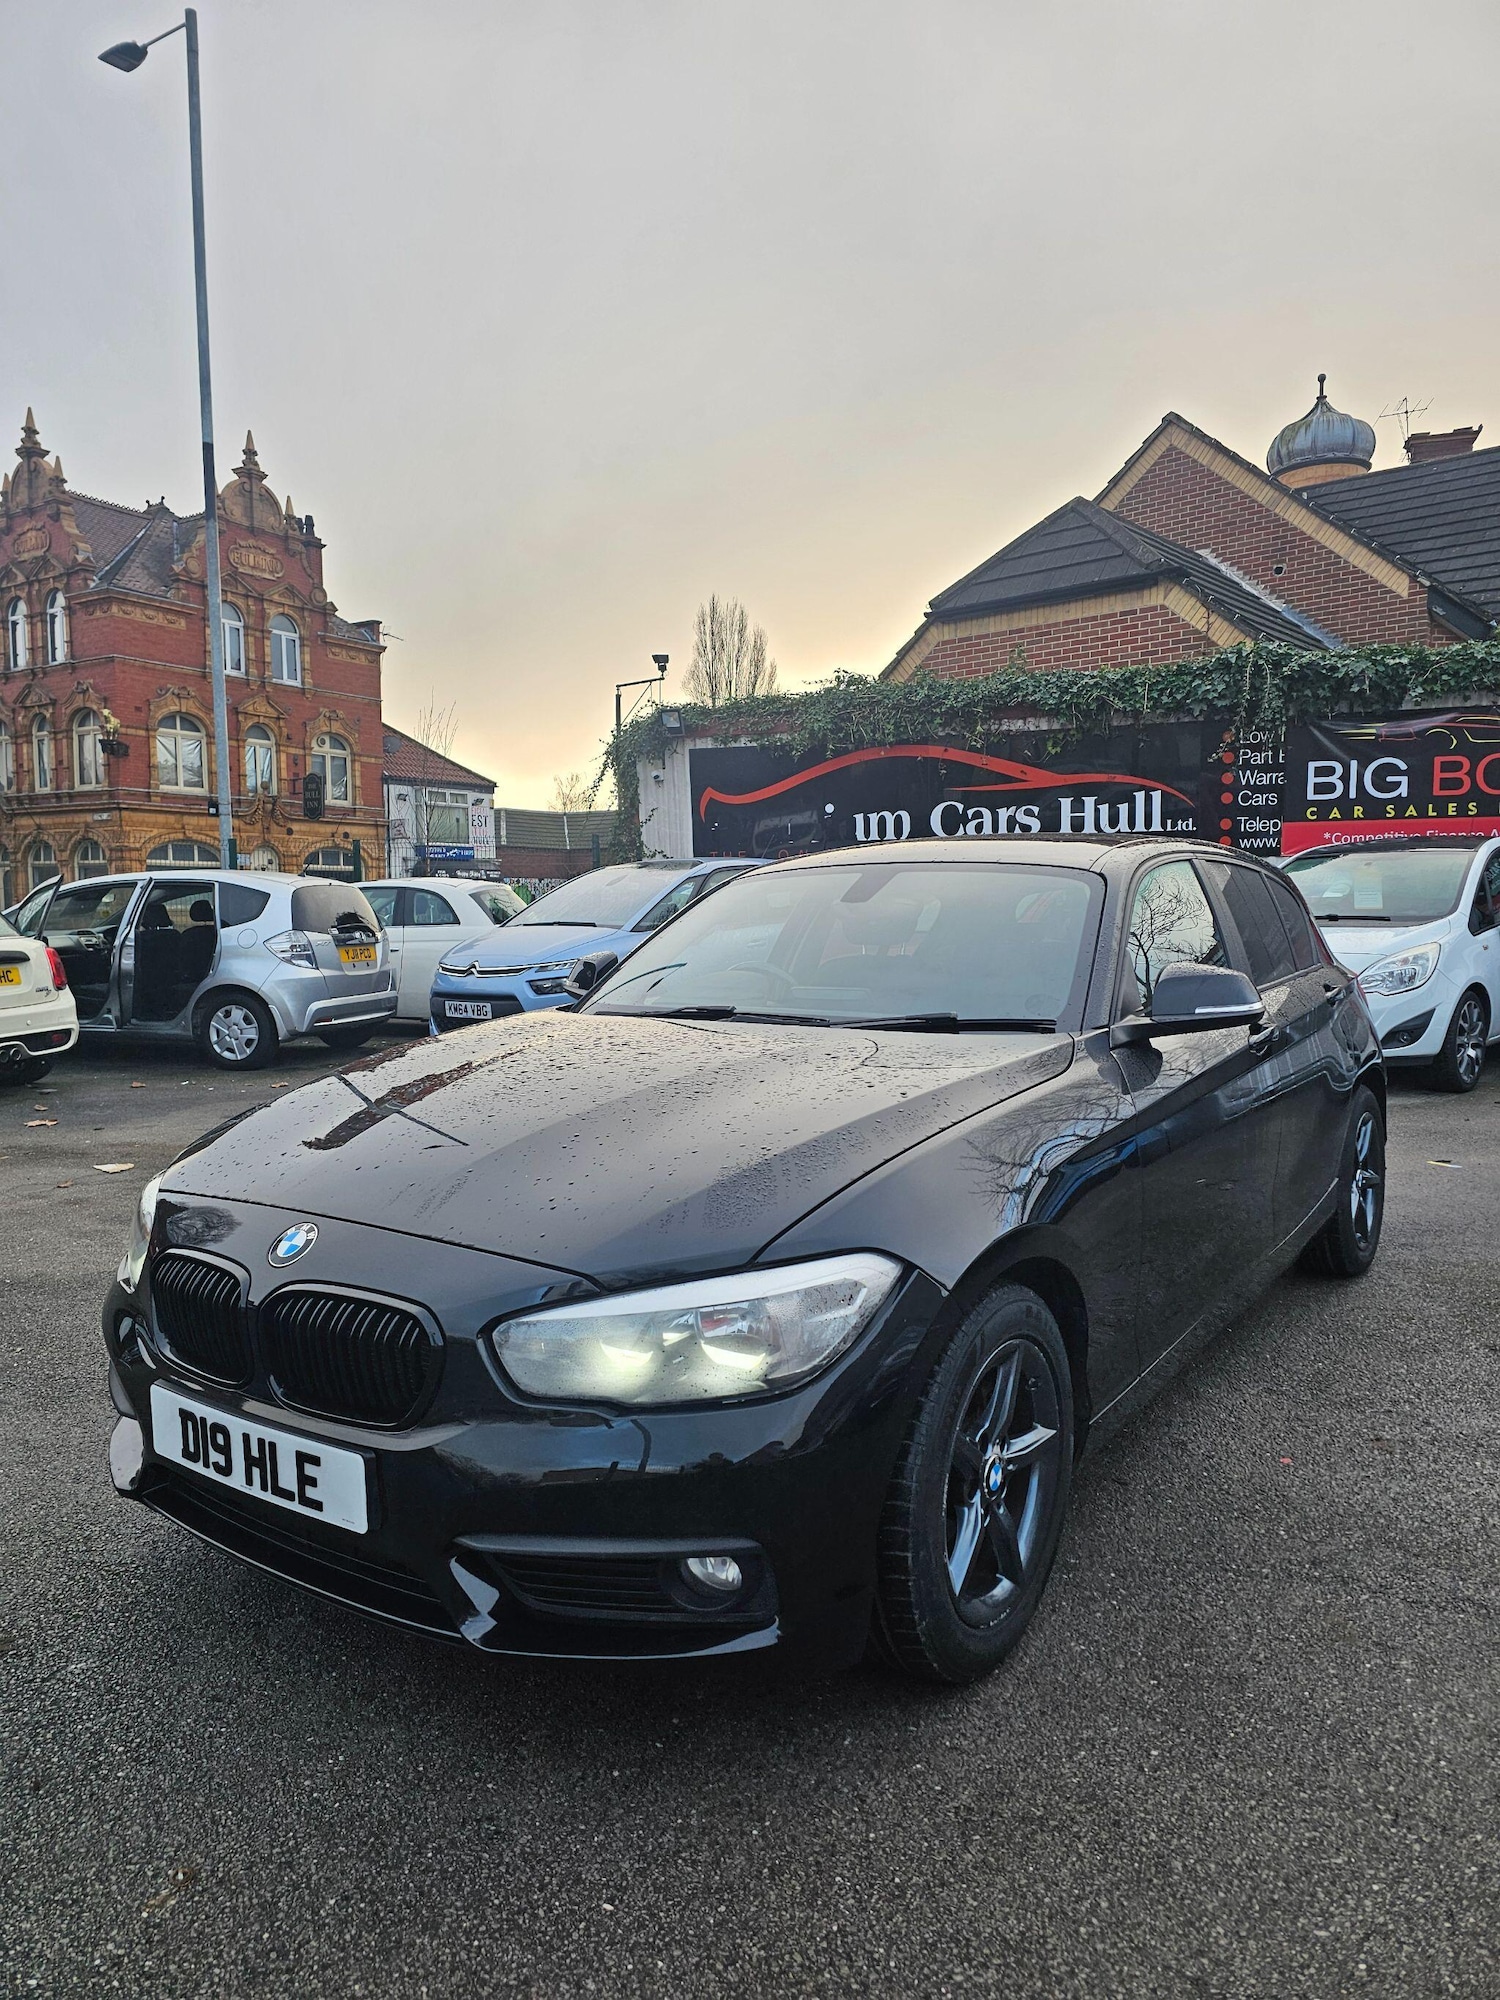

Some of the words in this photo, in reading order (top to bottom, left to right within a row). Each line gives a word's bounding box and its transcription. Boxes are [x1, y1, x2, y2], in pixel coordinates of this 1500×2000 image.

[1239, 749, 1273, 765] Part
[1307, 756, 1409, 801] BIG
[305, 790, 320, 799] BULL
[1238, 790, 1278, 806] Cars
[306, 800, 319, 809] INN
[1306, 806, 1364, 820] CAR
[1385, 801, 1478, 818] SALES
[930, 800, 1041, 837] Cars
[1057, 789, 1164, 834] Hull
[1166, 817, 1197, 831] Ltd.
[1237, 816, 1281, 835] Telep
[1239, 837, 1281, 848] www.
[448, 1002, 468, 1015] KM64
[470, 1004, 488, 1017] VBG
[179, 1407, 233, 1478] D19
[242, 1432, 324, 1513] HLE
